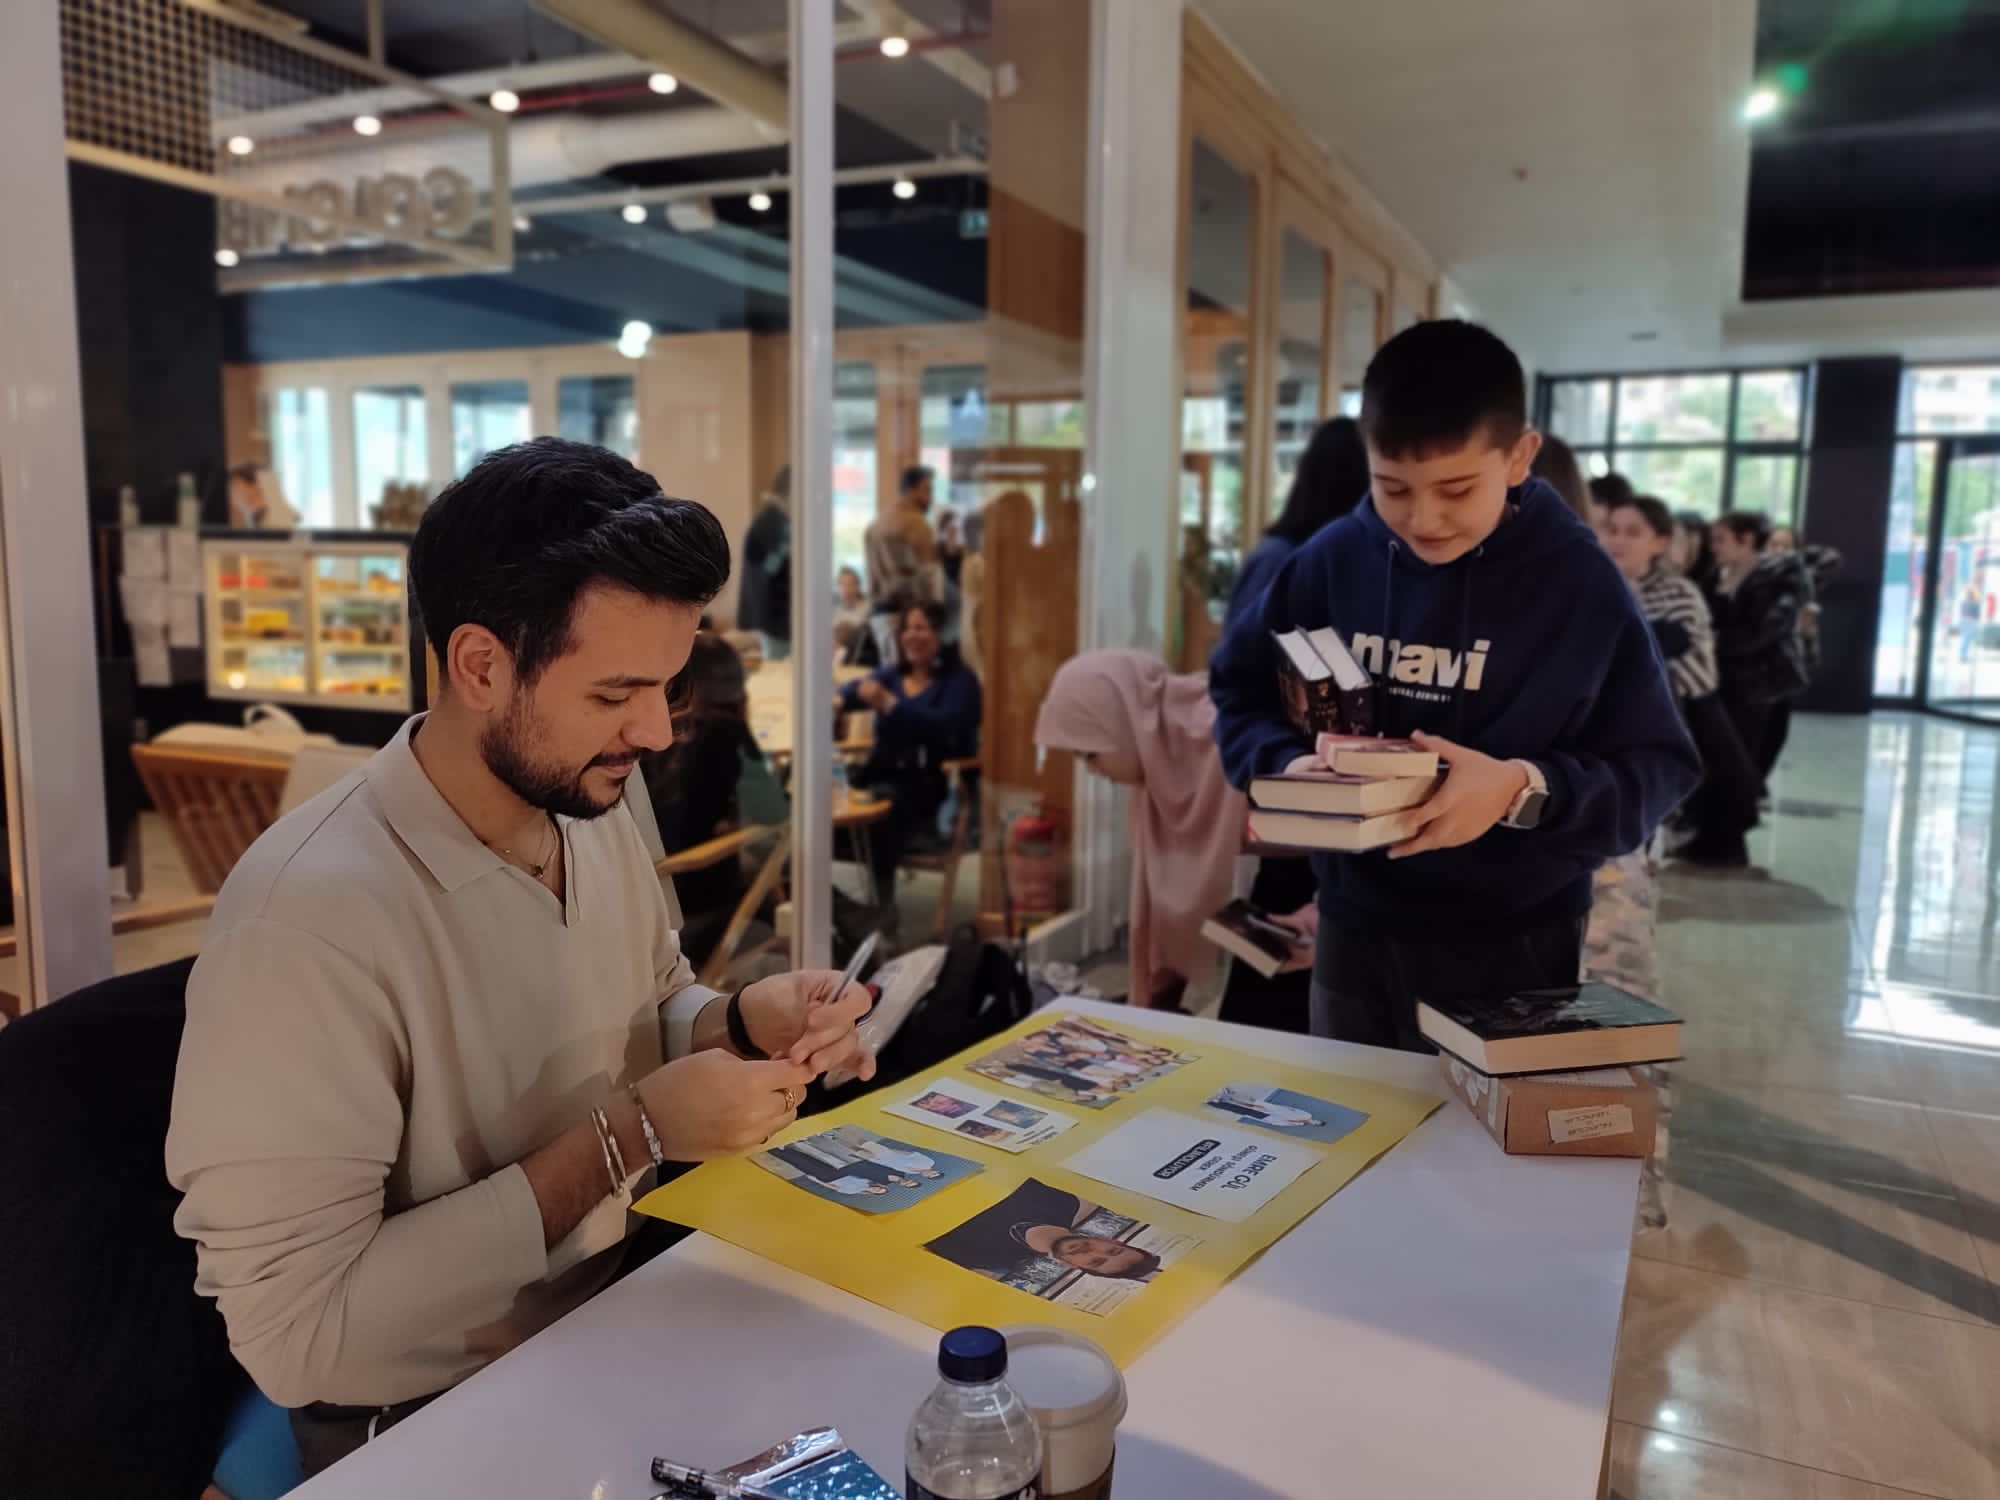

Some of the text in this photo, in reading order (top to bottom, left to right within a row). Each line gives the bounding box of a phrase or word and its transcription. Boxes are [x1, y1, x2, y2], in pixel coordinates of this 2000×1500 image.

[1352, 632, 1491, 691] mavi
[1221, 1153, 1277, 1190] EMRE GÜL
